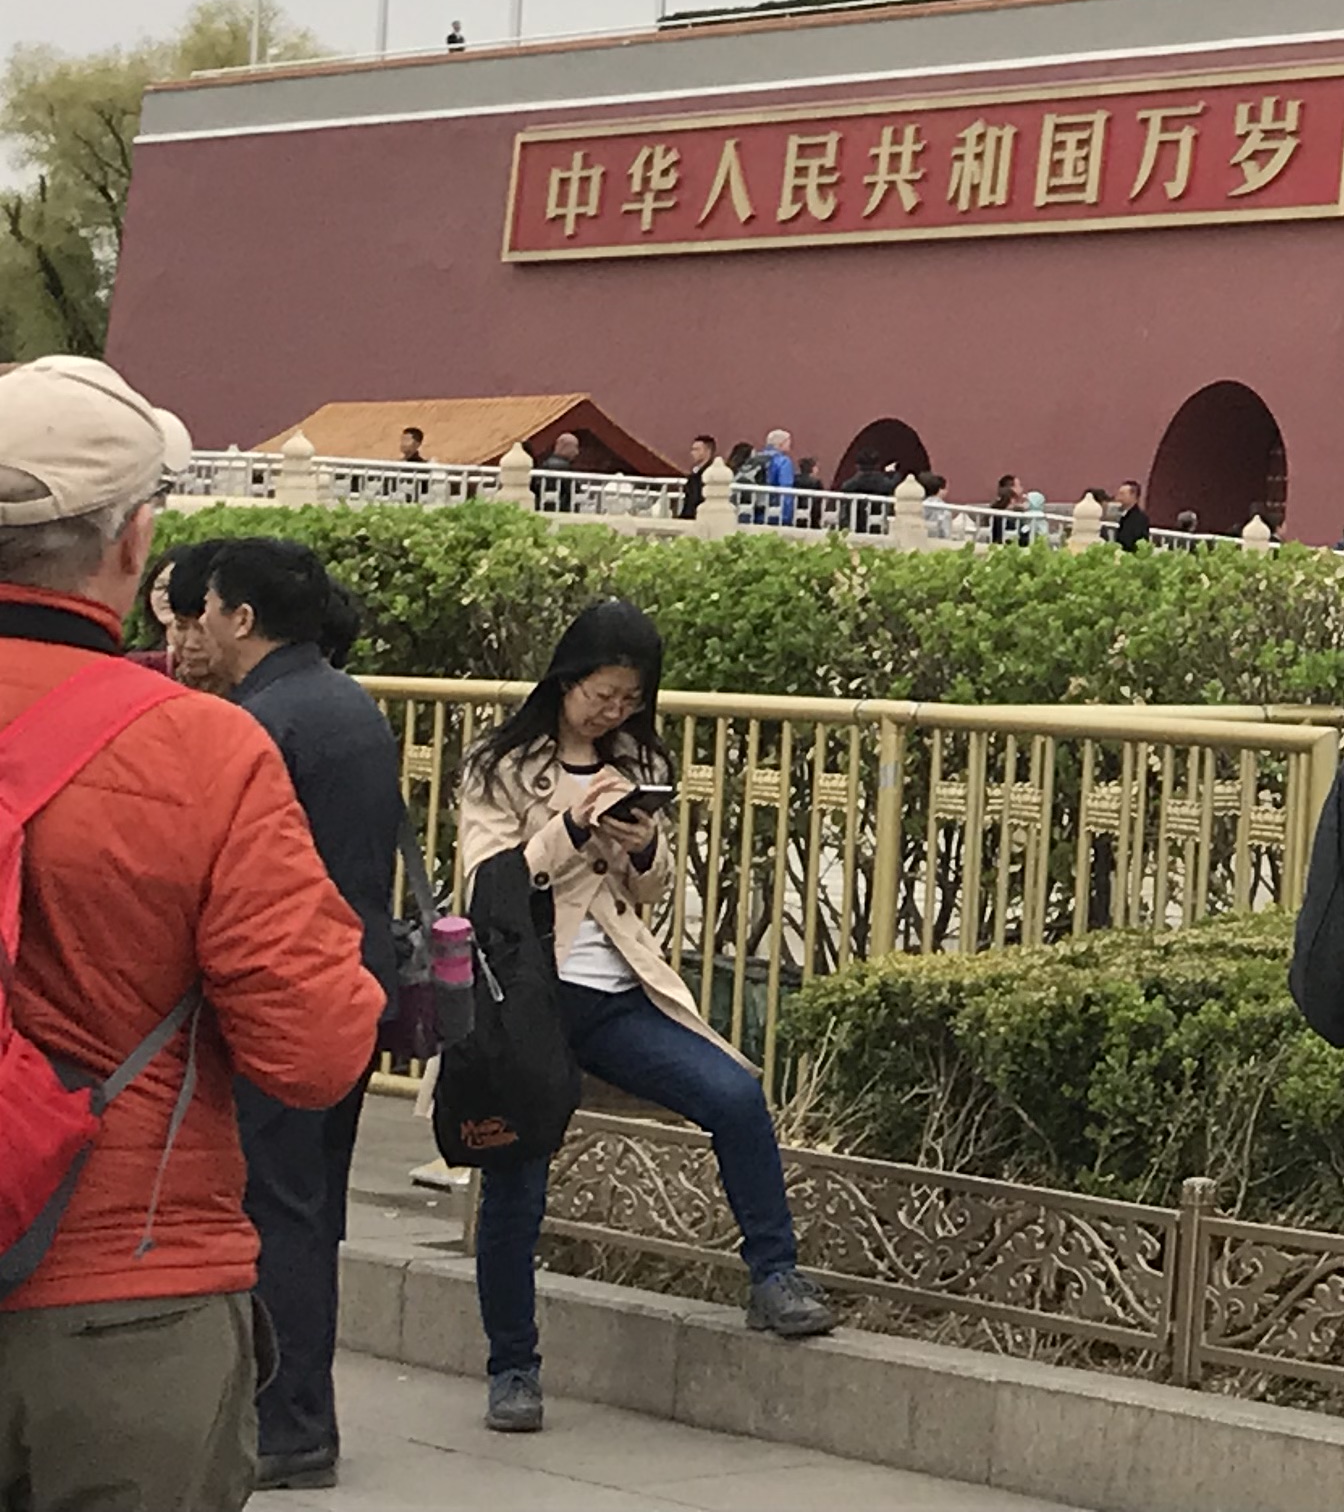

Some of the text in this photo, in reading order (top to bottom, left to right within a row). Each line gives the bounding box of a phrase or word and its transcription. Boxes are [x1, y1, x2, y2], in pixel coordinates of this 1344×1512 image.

[544, 96, 1303, 237] 中华人民共和国万岁
